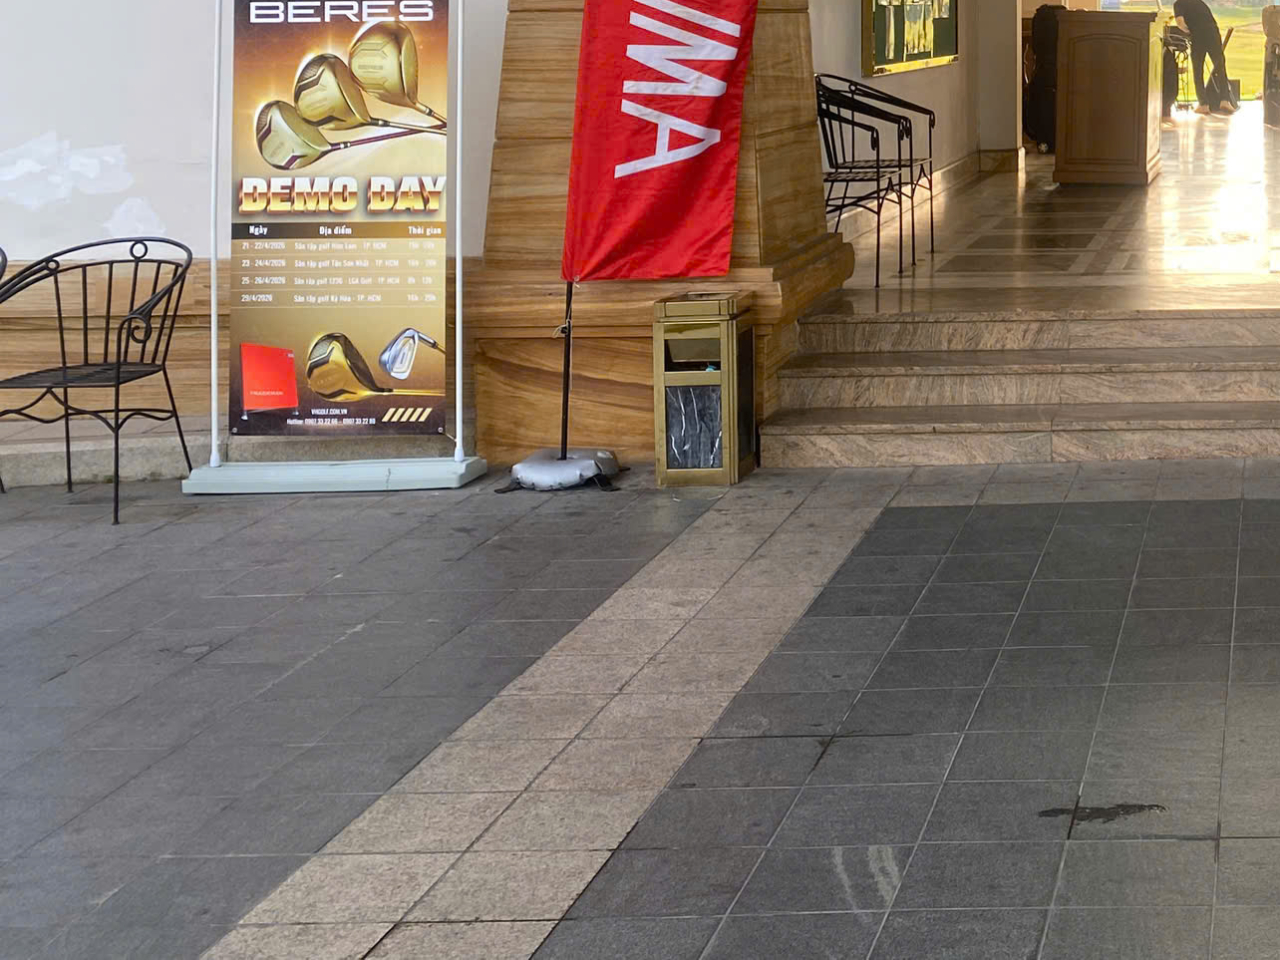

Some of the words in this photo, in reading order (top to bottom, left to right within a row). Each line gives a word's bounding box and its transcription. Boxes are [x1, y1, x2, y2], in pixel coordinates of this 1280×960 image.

[249, 0, 434, 23] BERES
[238, 175, 359, 215] DEMO
[367, 175, 447, 216] DAY
[249, 225, 268, 236] Ngày
